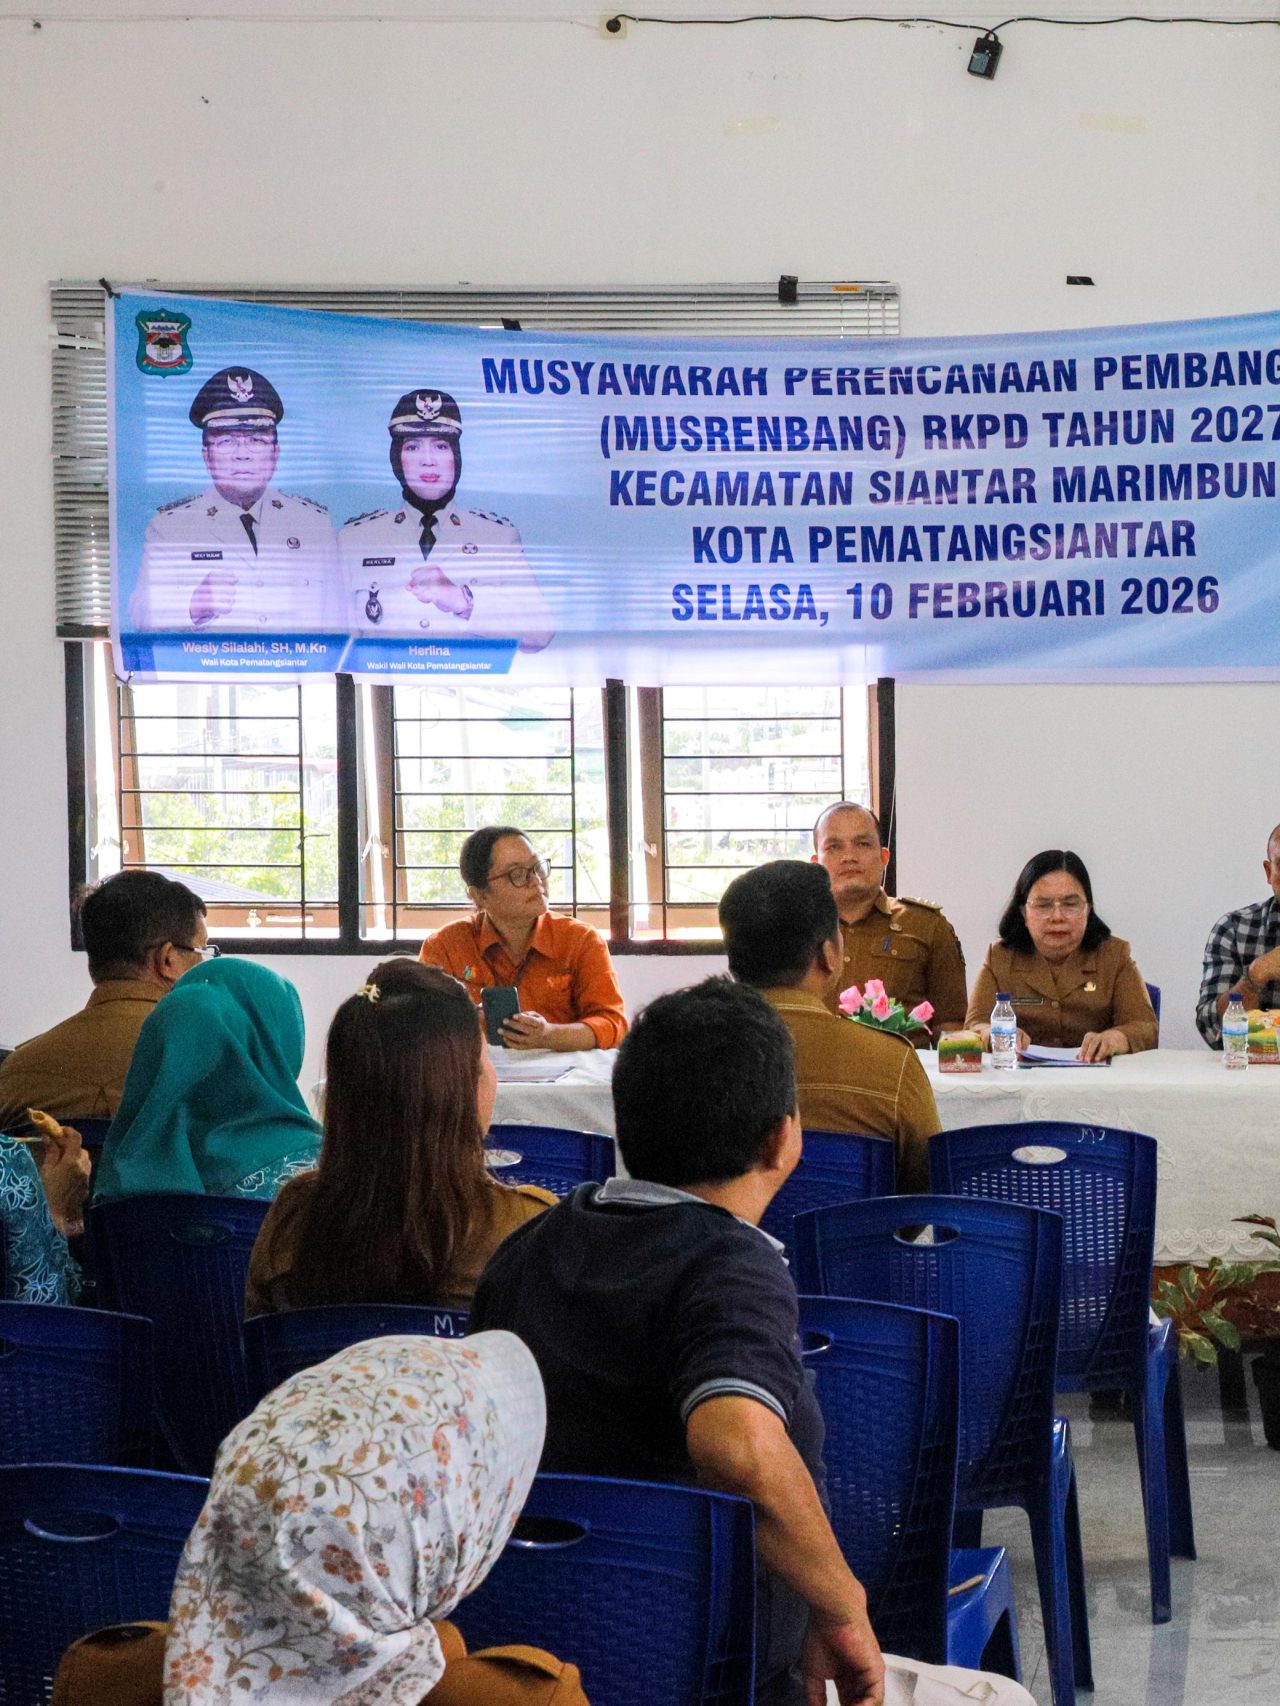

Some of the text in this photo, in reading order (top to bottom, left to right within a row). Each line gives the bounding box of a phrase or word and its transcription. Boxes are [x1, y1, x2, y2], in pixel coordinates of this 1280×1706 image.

[481, 357, 769, 396] MUSYAWARAH
[784, 358, 1078, 397] PERENCANAAN
[600, 415, 906, 459] (MUSRENBANG)
[922, 413, 1029, 450] RKPD
[1042, 408, 1175, 448] TAHUN
[609, 461, 1277, 506] KECAMATAN SIANTAR MARIMBUN
[692, 519, 1197, 564] KOTA PEMATANGSIANTAR
[671, 575, 1220, 628] SELASA, 10 FEBRUARI 2026
[182, 641, 327, 656] Wesly Silalahi, SH, M.Kn
[201, 657, 308, 669] Wali Kota Pematangsiantar
[366, 661, 492, 672] Wakil Wali Kota Pematangsiantar
[408, 645, 451, 657] Herlina
